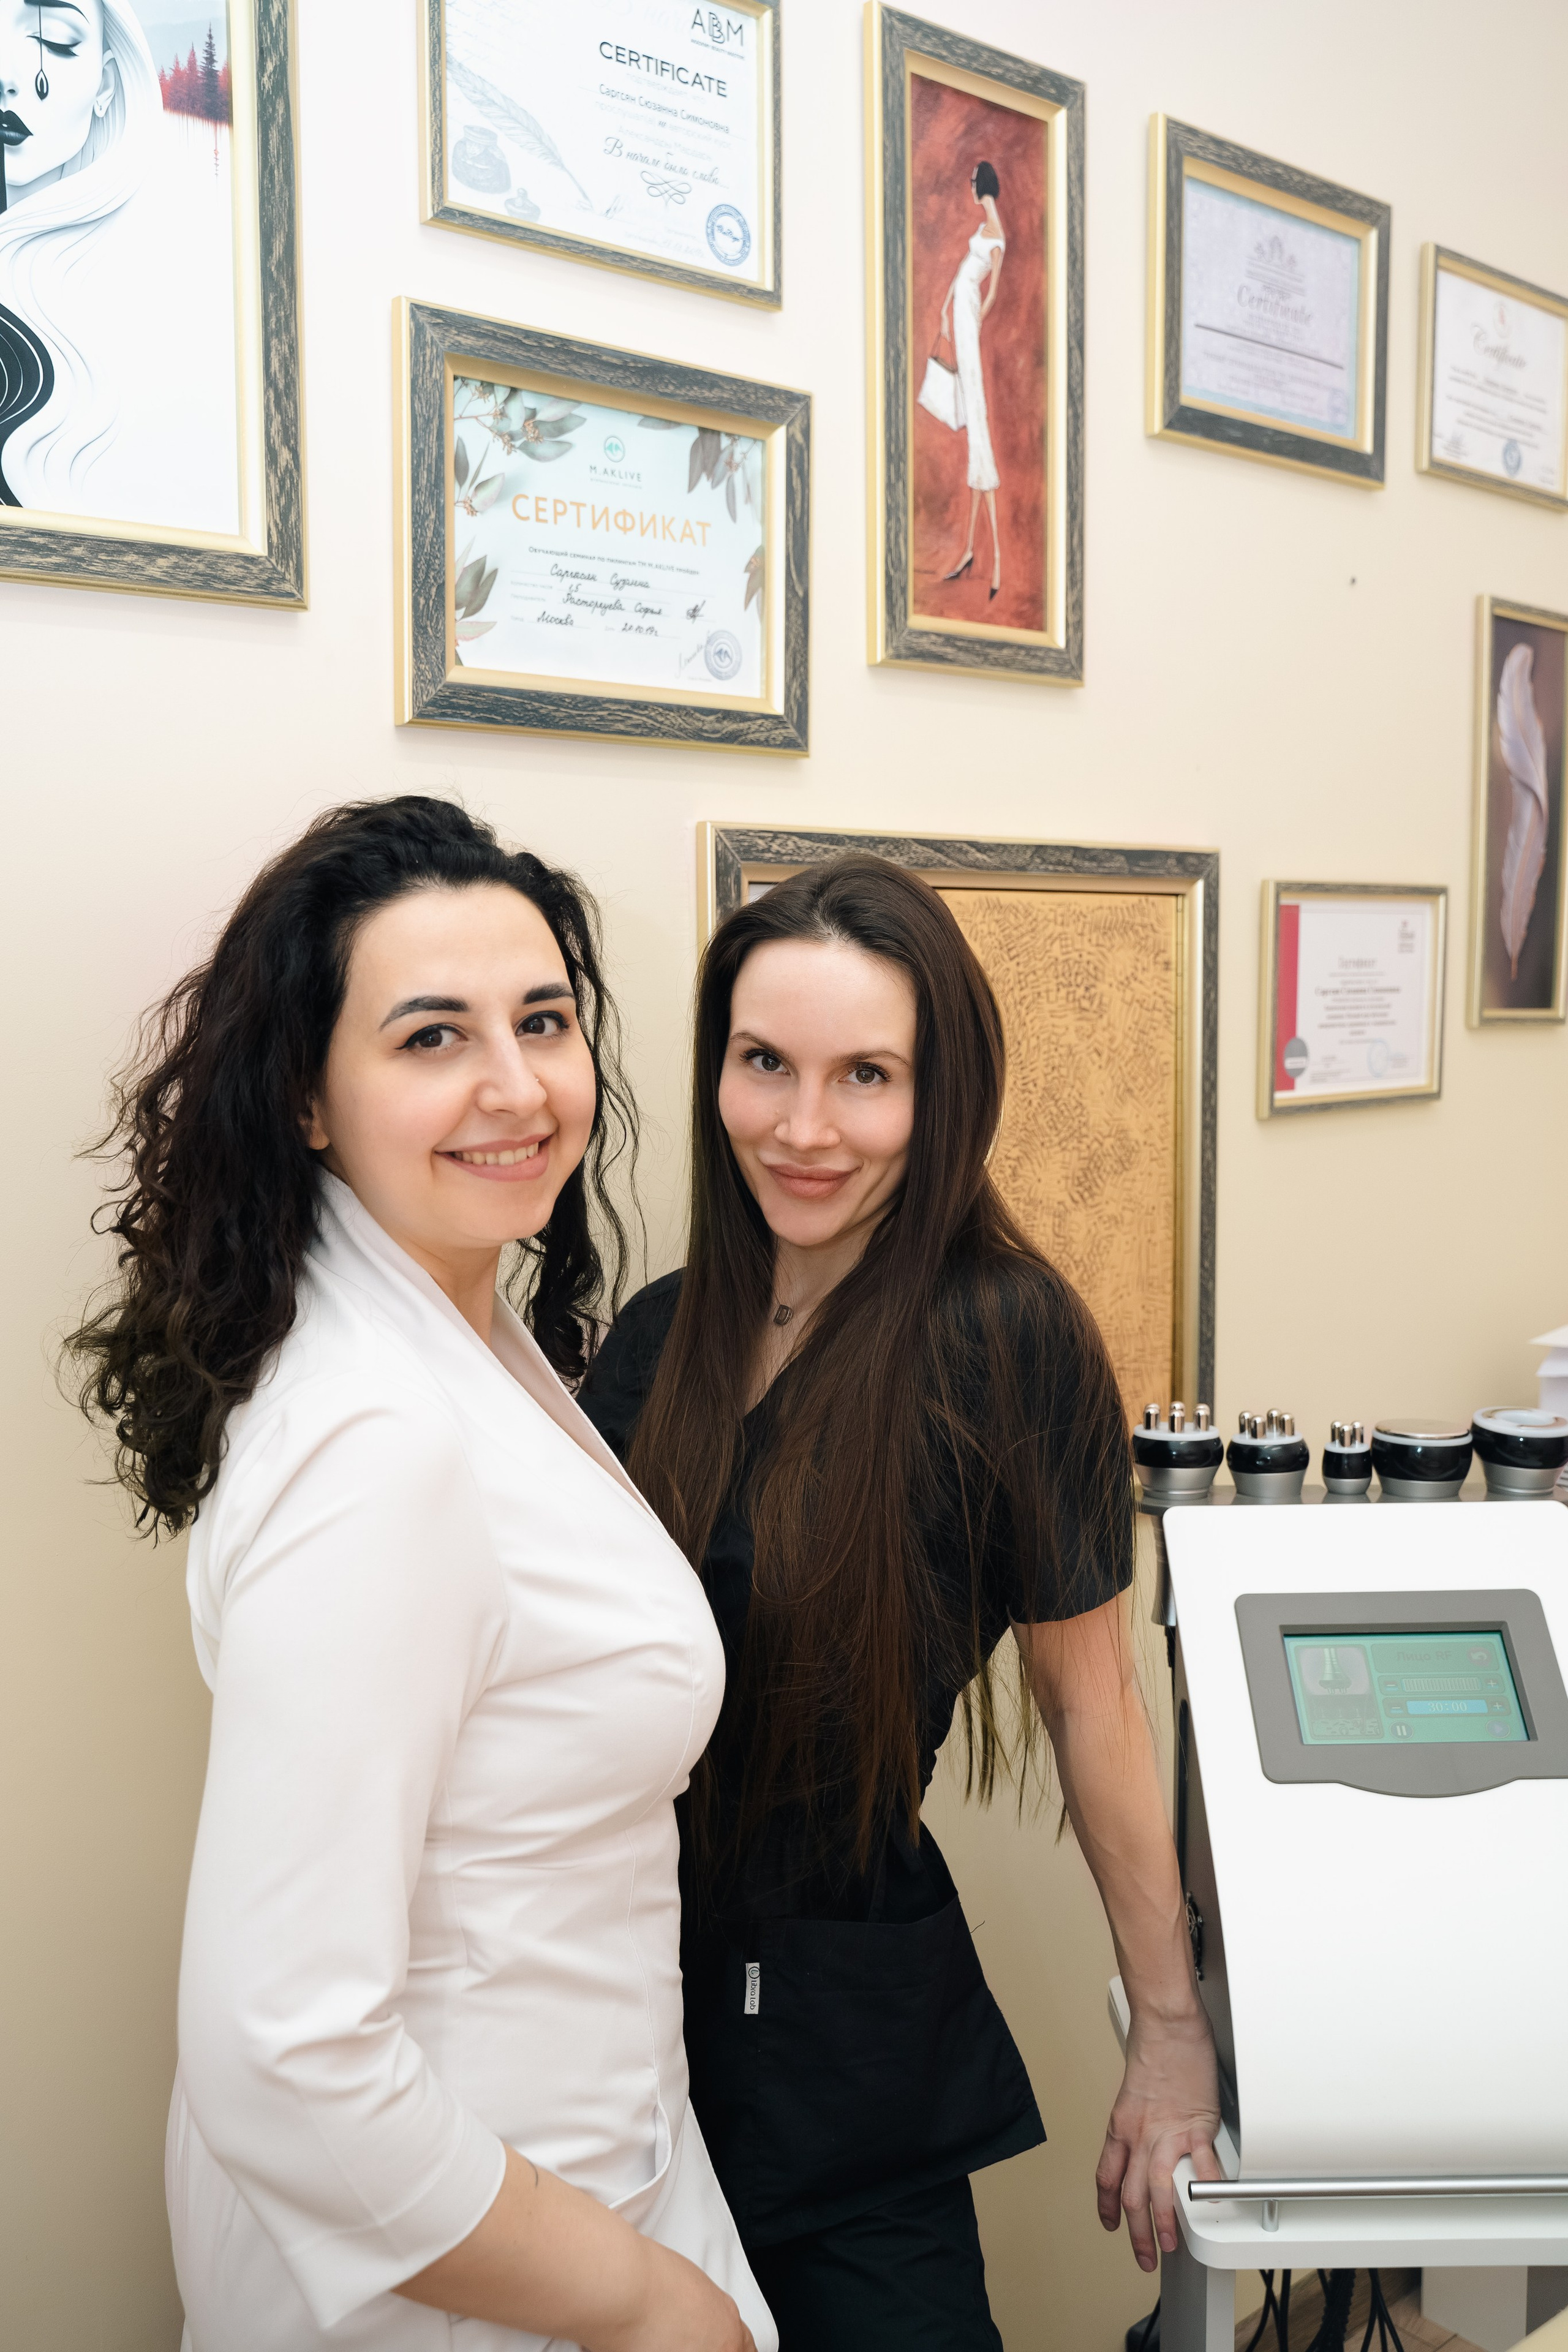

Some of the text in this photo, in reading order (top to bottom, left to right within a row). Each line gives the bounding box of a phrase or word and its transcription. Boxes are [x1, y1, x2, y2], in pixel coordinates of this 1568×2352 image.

[599, 41, 728, 97] CERTIFICATE
[638, 96, 678, 116] Сюзанна
[680, 109, 729, 134] Симоновна
[603, 137, 624, 157] В
[625, 151, 661, 167] начале
[511, 493, 711, 547] СЕРТИФИКАТ
[1435, 1651, 1452, 1661] RF
[1428, 1701, 1468, 1713] 30:00
